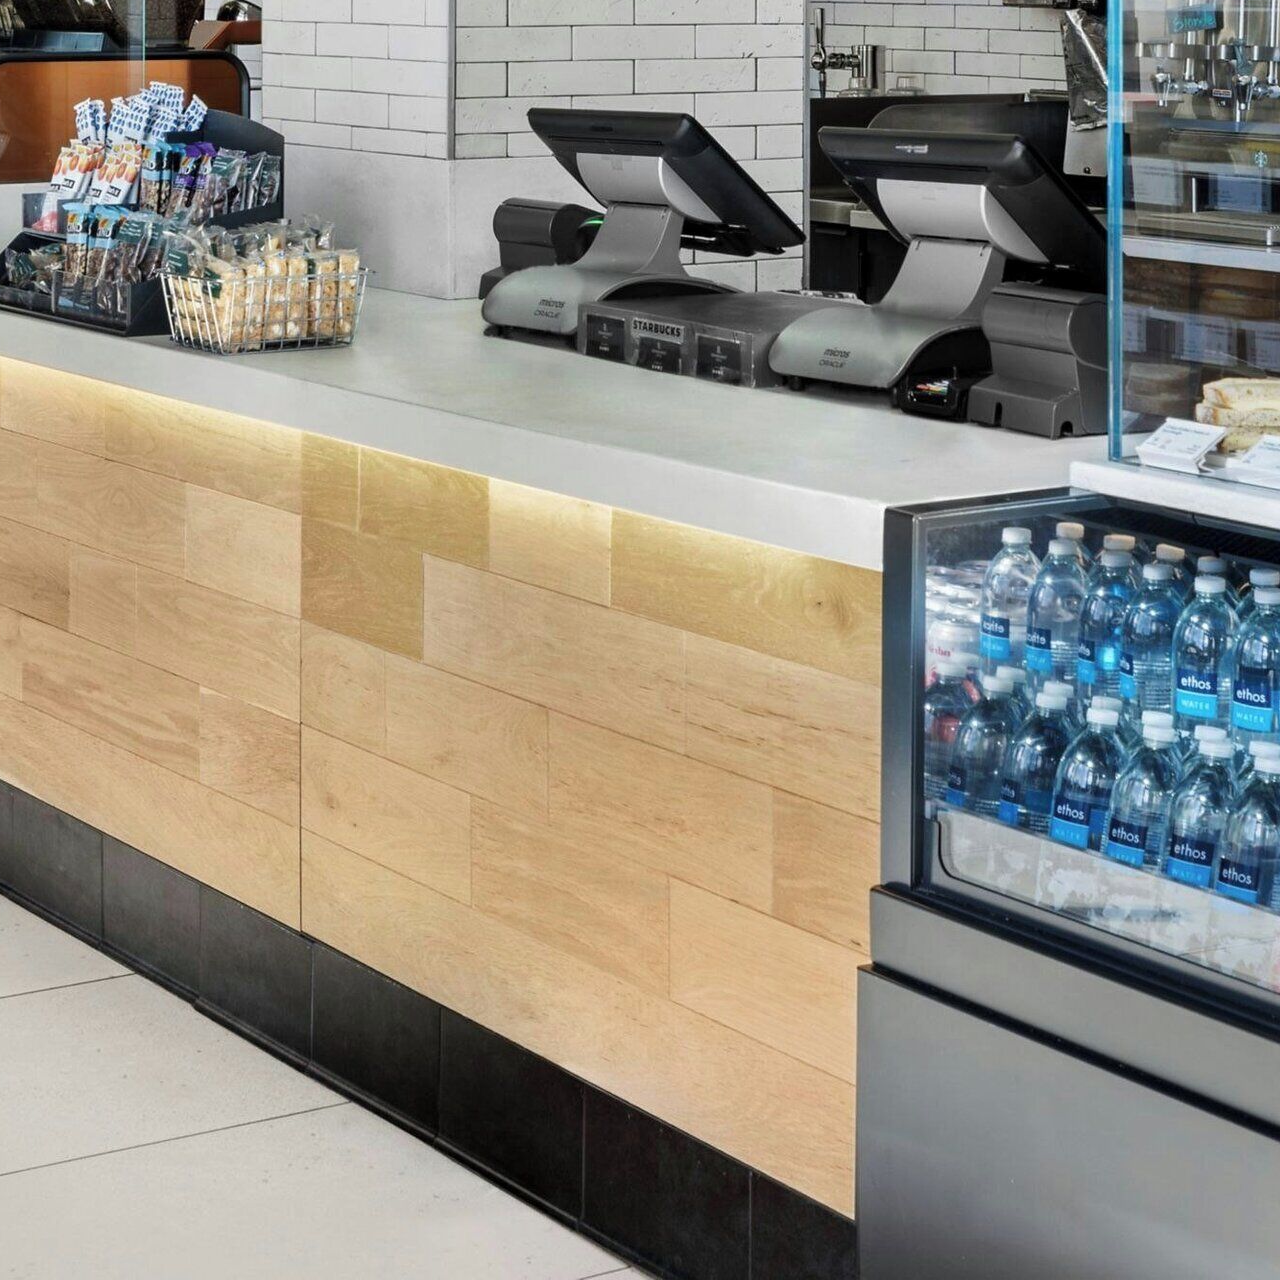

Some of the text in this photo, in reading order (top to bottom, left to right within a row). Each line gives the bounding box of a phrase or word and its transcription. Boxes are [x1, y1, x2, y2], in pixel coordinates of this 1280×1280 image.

[632, 320, 681, 338] STARBUCKS
[1181, 676, 1211, 690] ethos
[1236, 688, 1266, 703] ethos
[1056, 804, 1084, 820] ethos
[1112, 827, 1140, 844] ethos
[1174, 842, 1206, 860] ethos
[1222, 868, 1252, 885] ethos
